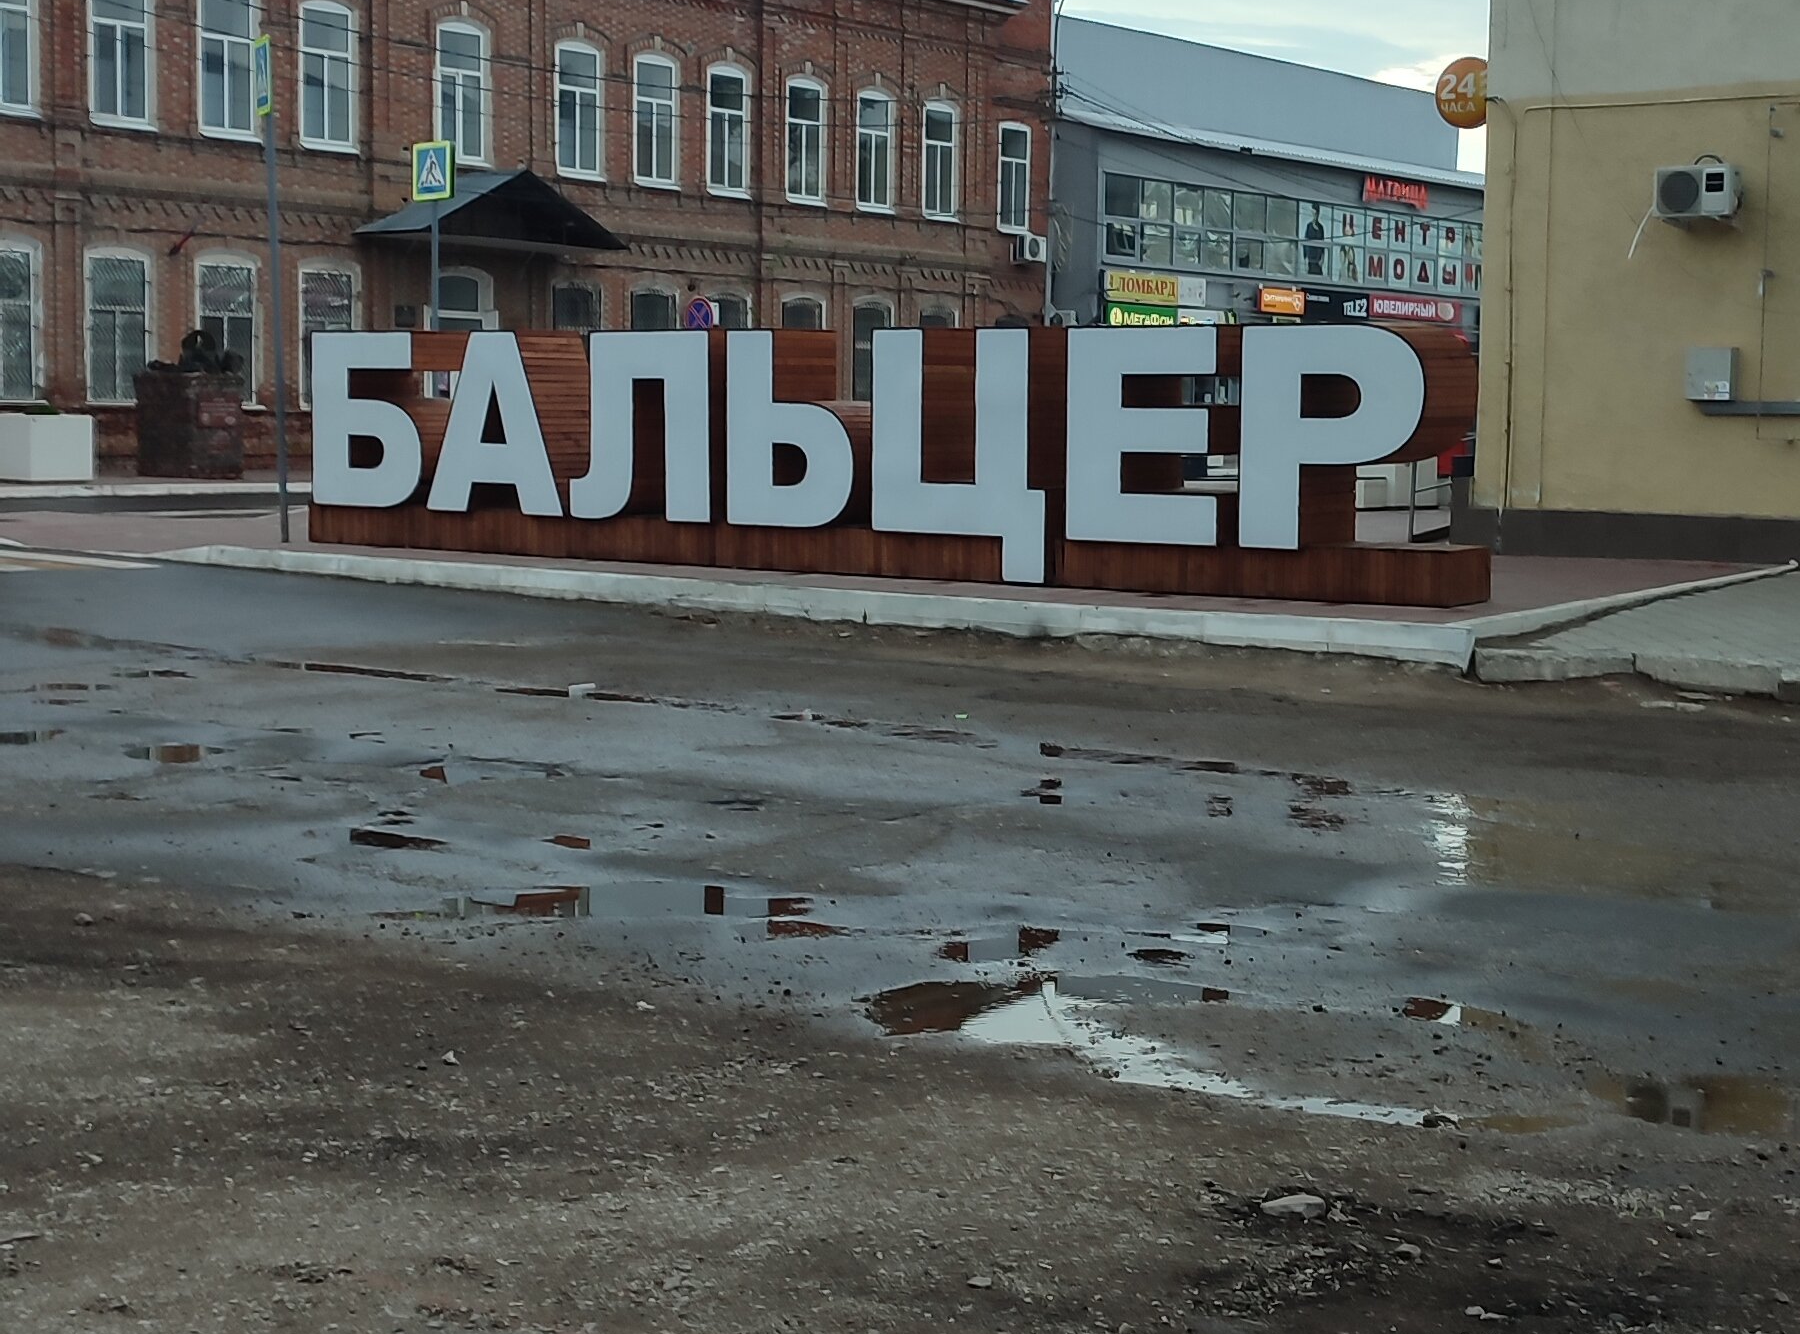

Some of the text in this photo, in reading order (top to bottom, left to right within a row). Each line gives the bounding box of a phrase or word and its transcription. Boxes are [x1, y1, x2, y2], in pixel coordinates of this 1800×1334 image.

[1440, 72, 1476, 100] 24
[1440, 101, 1476, 113] ЧАСА
[1342, 212, 1456, 246] ЦЕНТР
[1367, 255, 1457, 285] МОДЫ
[1118, 276, 1176, 298] ЛОМБАРД
[1343, 298, 1368, 318] TELE2
[1373, 298, 1436, 318] ЮВЕЛИРНЫЙ
[311, 324, 1426, 584] БАЛЬЦЕР
